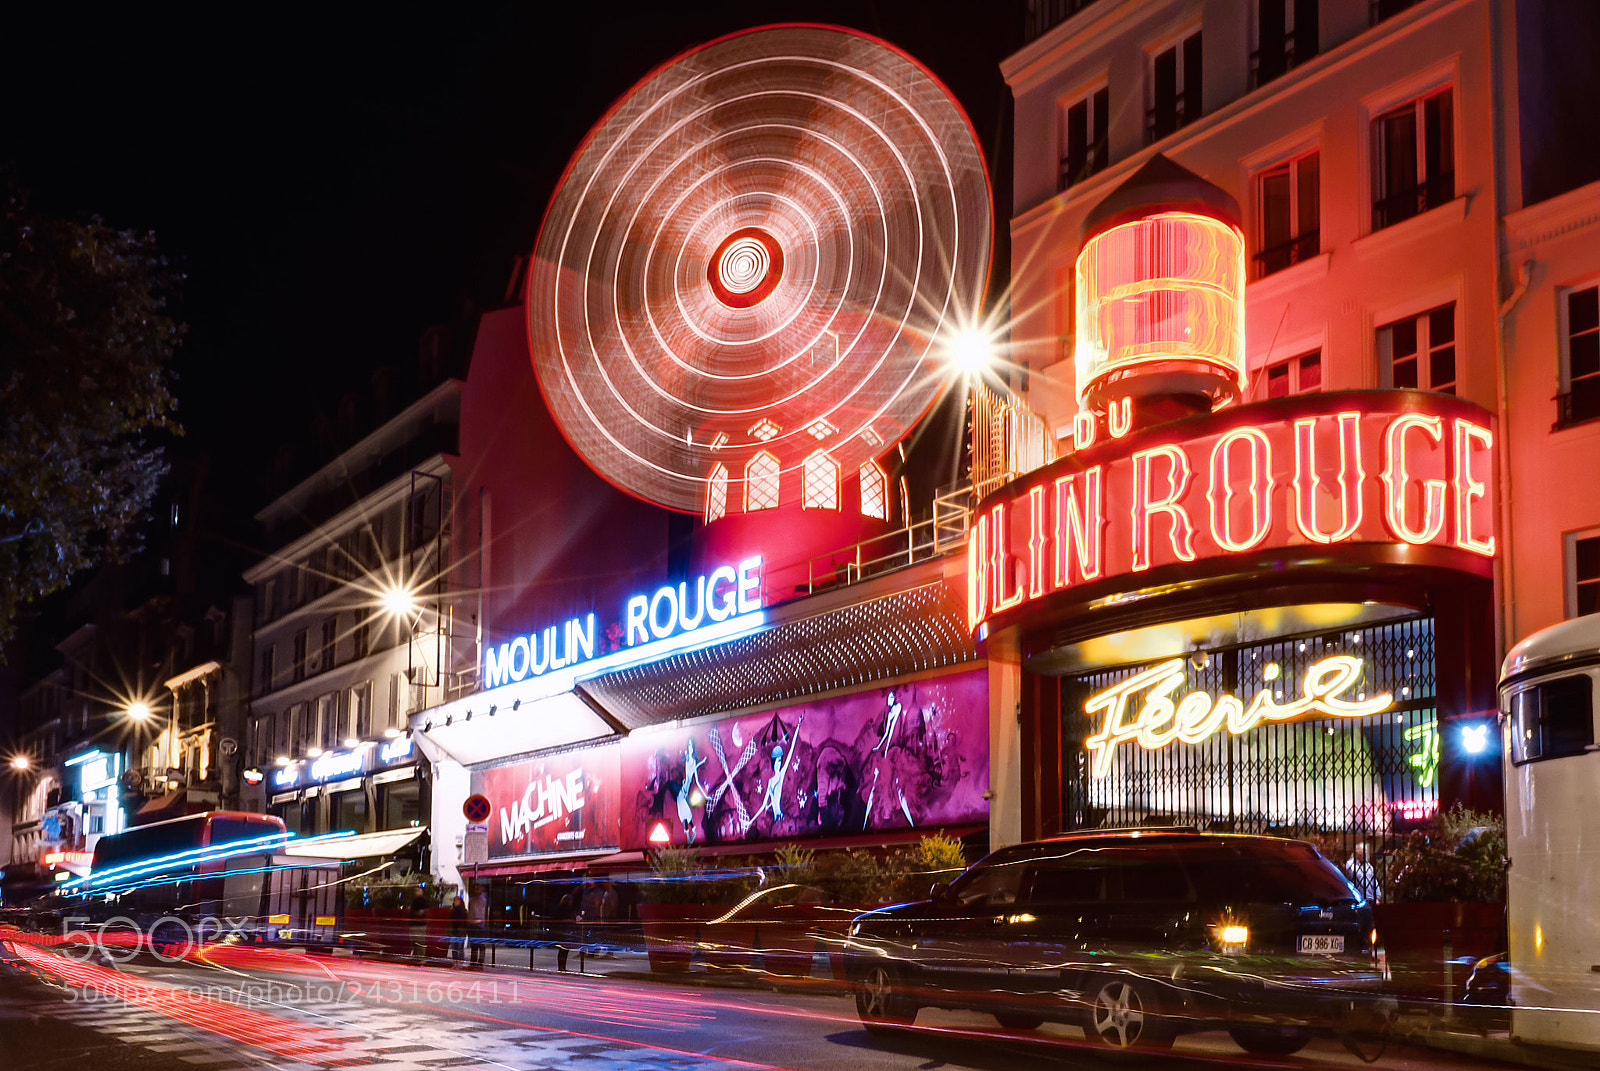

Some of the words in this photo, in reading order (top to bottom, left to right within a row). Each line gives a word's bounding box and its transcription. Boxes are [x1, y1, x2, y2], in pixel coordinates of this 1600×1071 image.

[1073, 396, 1132, 450] DU
[1131, 411, 1495, 572] ROUGE
[485, 613, 595, 688] MOULIN
[627, 555, 763, 647] ROUGE
[500, 767, 585, 845] MACHINE
